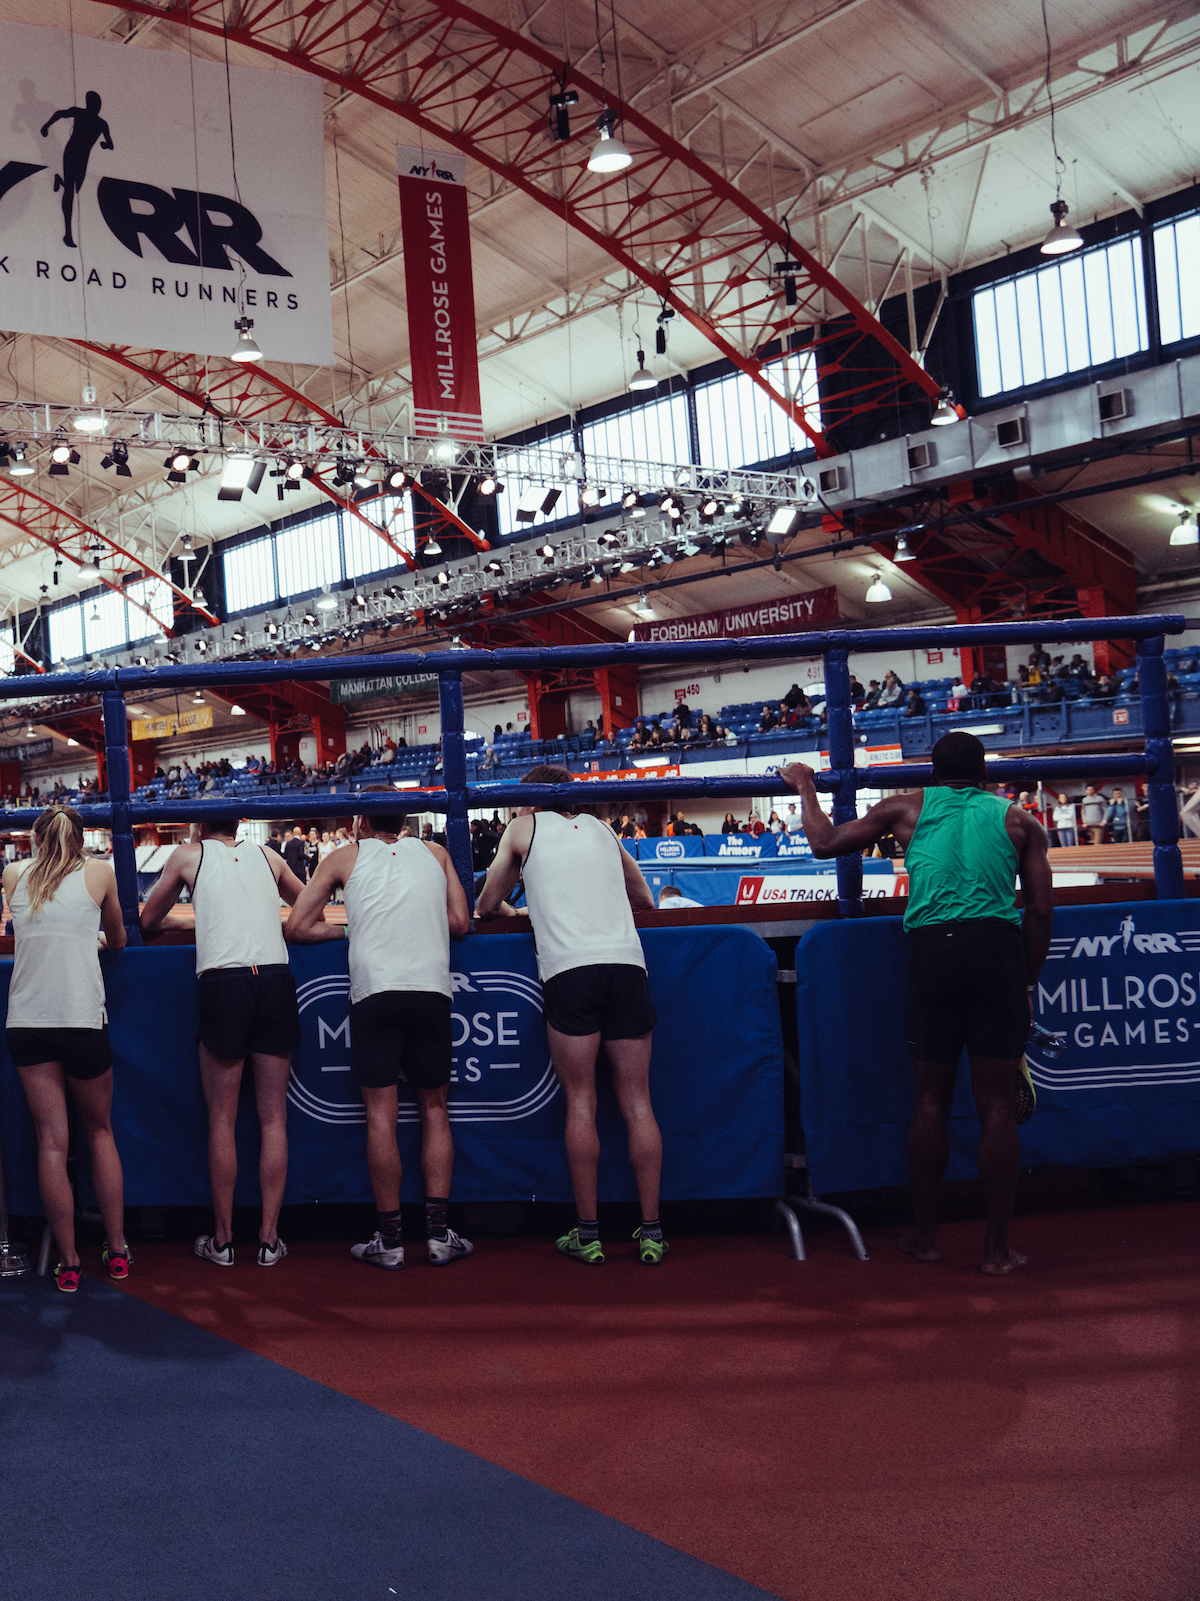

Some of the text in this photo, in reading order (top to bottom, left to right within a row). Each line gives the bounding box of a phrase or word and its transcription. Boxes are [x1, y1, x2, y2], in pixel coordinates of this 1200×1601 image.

[36, 260, 127, 290] ROAD
[153, 277, 299, 311] RUNNERS
[426, 191, 456, 400] MILLROSE GAMES
[650, 599, 815, 641] FORDHAM UNIVERSITY
[340, 676, 393, 696] MANHATTAN
[687, 683, 700, 695] 450
[145, 720, 168, 733] HUNTER
[869, 753, 889, 761] ATHLETIC
[727, 835, 743, 846] The
[718, 844, 762, 858] Armory
[777, 844, 812, 856] Armo
[762, 889, 787, 900] USA
[790, 888, 834, 901] TRACK
[1070, 932, 1184, 958] NYRR
[1037, 972, 1200, 1015] MILLROS
[1073, 1017, 1189, 1048] GAMES
